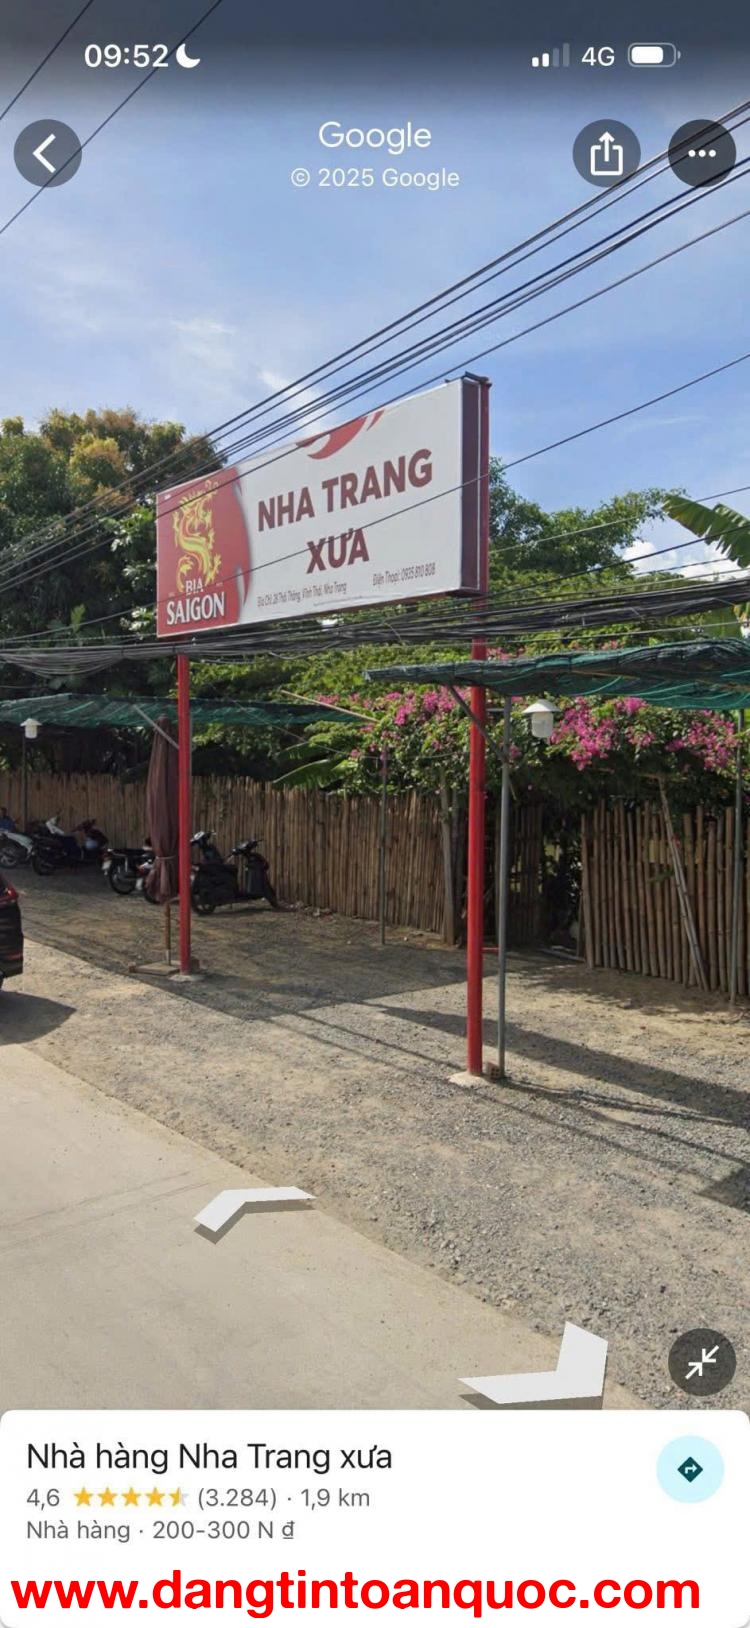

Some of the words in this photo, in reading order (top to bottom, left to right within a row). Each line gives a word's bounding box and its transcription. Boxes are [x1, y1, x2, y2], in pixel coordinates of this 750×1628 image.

[258, 487, 315, 532] NHA
[322, 449, 432, 512] TRANG
[306, 528, 369, 574] XƯA
[185, 578, 204, 595] BIA
[166, 591, 225, 626] SAIGON
